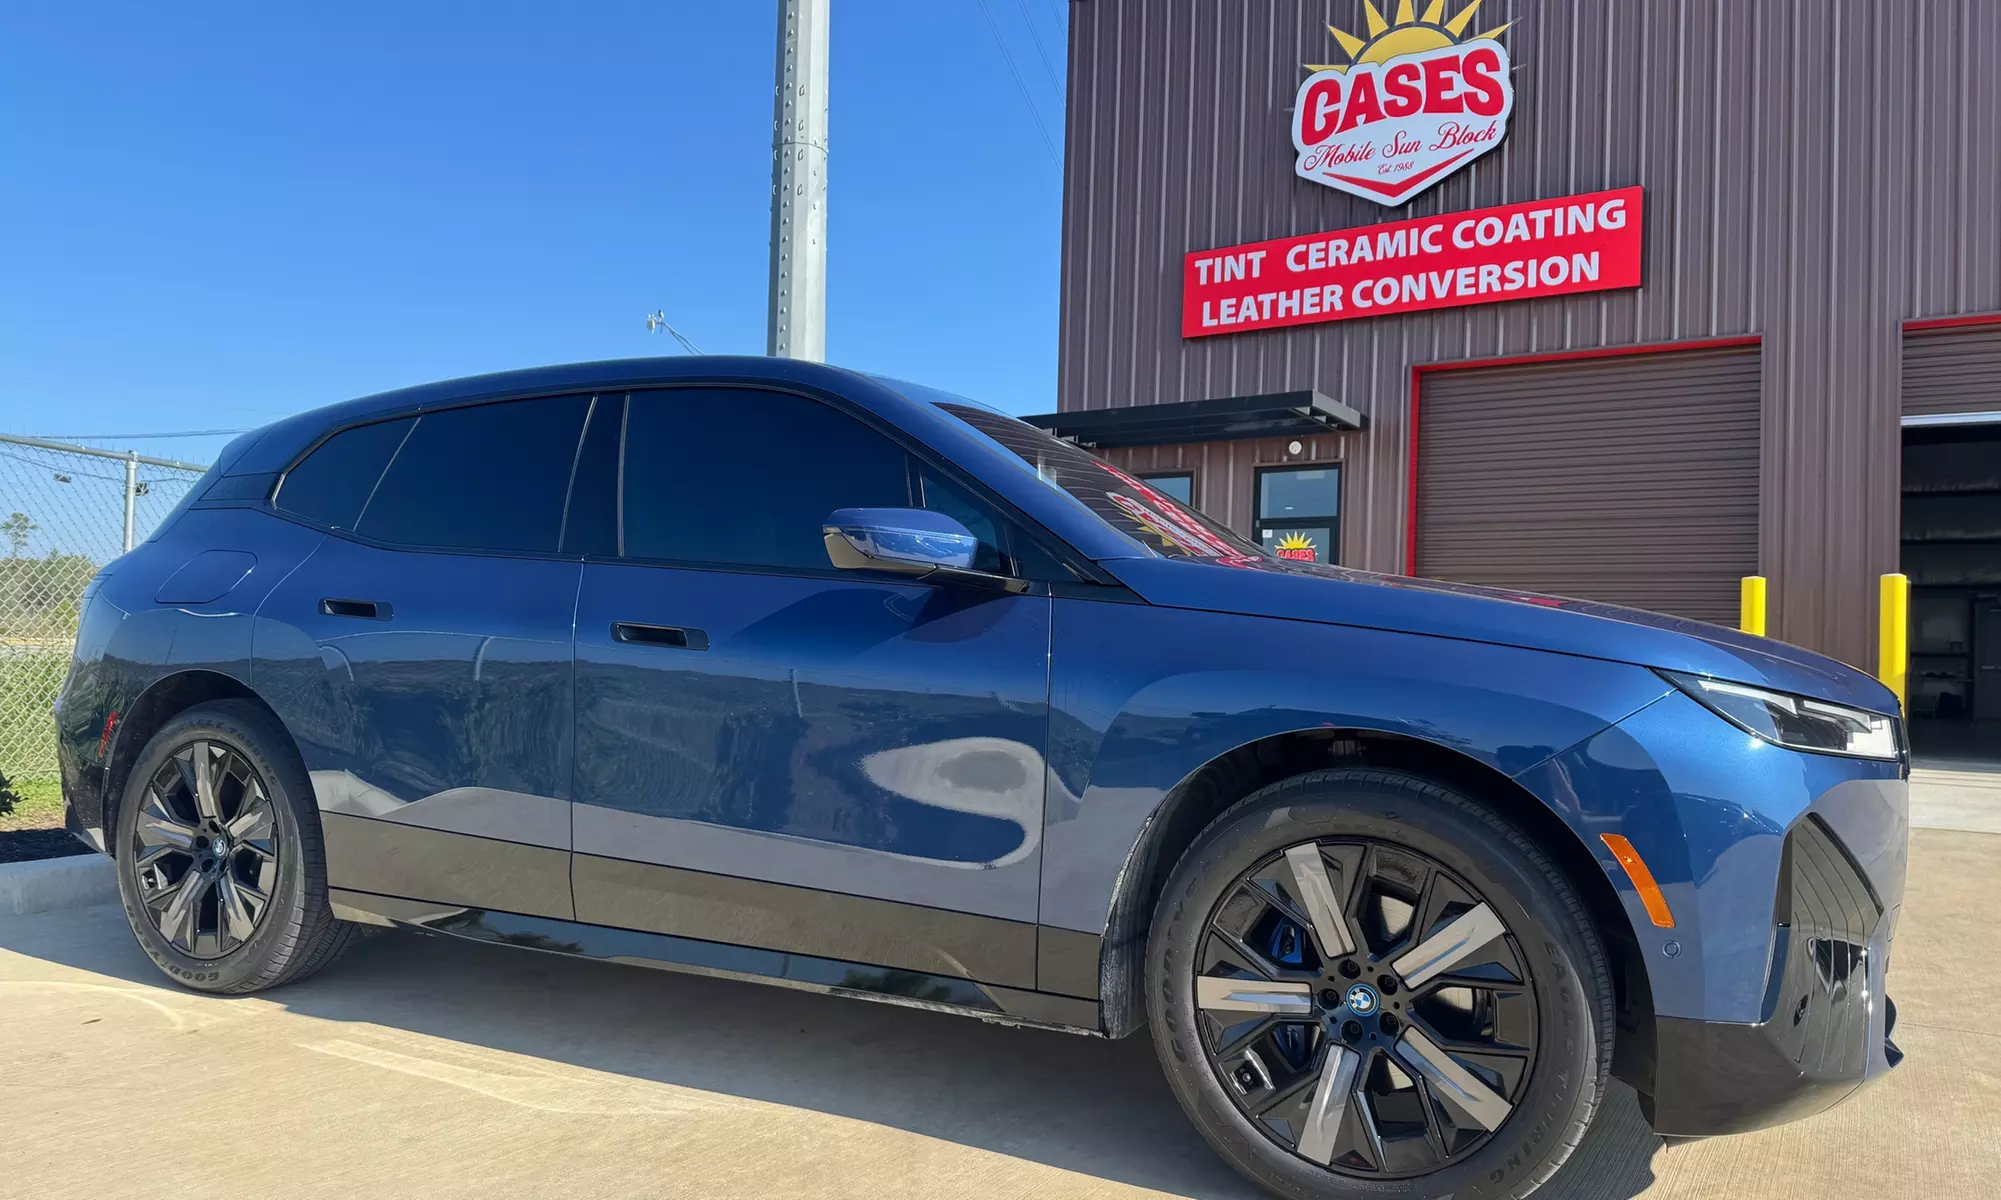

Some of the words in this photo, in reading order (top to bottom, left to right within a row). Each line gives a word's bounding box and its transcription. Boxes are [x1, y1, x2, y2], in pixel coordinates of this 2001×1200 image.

[1301, 48, 1505, 147] CASES
[1303, 141, 1376, 172] Mobile
[1382, 130, 1422, 159] Sun
[1428, 119, 1498, 152] Block
[1393, 160, 1415, 172] 1988
[1194, 250, 1267, 286] TINT
[1286, 224, 1444, 273] CERAMIC
[1452, 198, 1626, 249] COATING
[1202, 284, 1344, 327] LEATHER
[1351, 251, 1600, 308] CONVERSION
[1276, 549, 1315, 562] CASES
